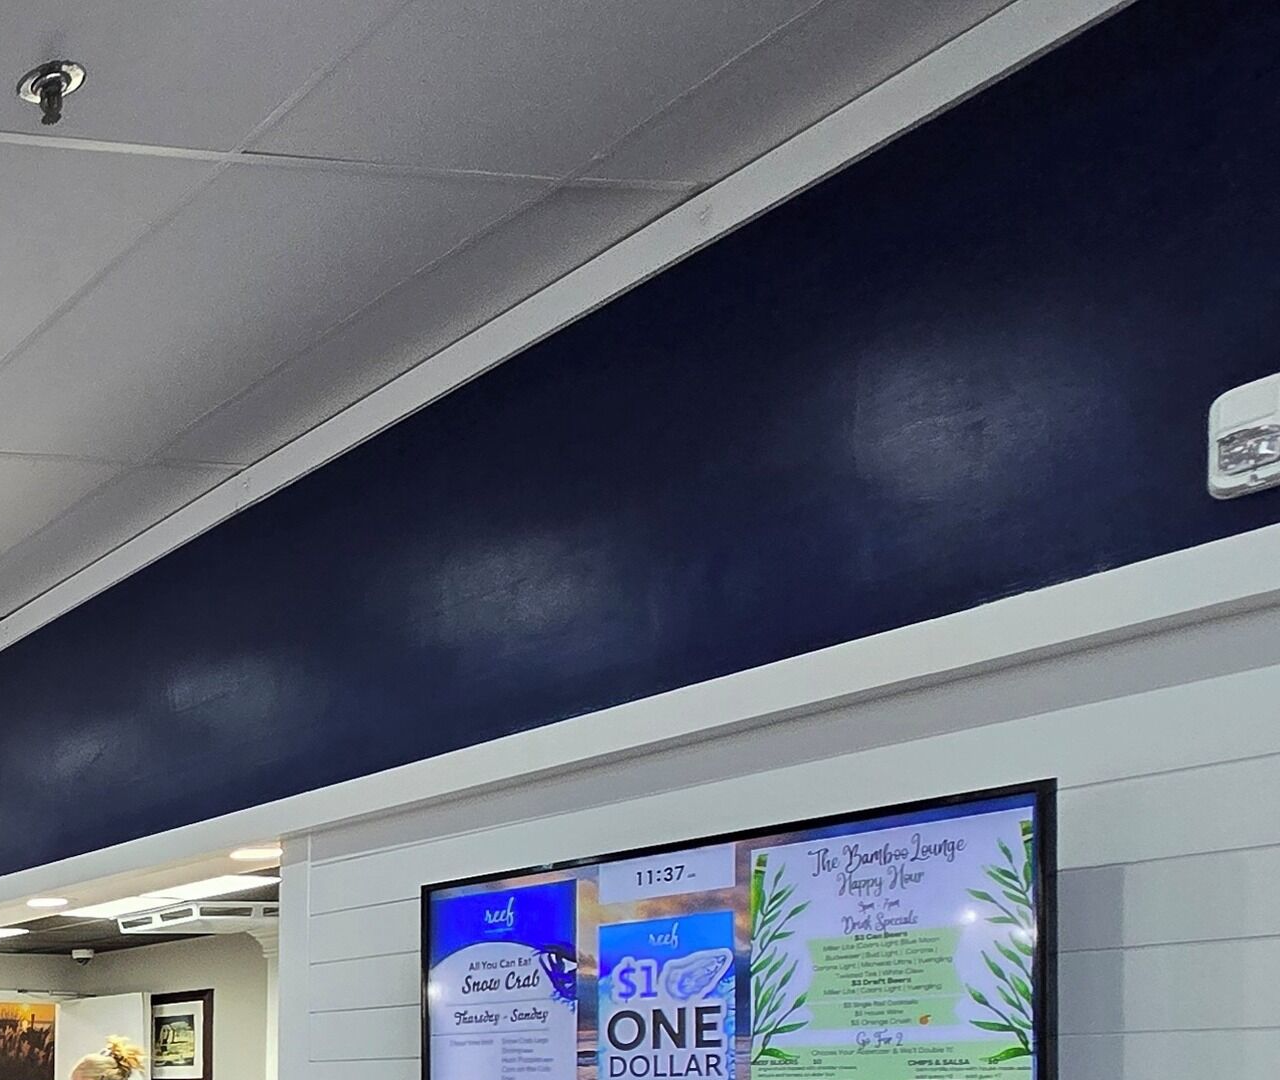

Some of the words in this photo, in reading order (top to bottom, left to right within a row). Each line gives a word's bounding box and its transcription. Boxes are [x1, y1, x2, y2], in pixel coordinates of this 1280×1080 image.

[808, 848, 838, 877] The
[842, 843, 909, 874] Bamboo
[910, 833, 967, 862] Lounge
[636, 865, 684, 886] 11:37
[836, 872, 882, 897] Happy
[888, 864, 925, 890] Hour
[484, 896, 514, 927] reef
[648, 922, 678, 948] reef
[468, 962, 480, 971] All
[482, 960, 498, 970] You
[500, 958, 516, 968] Can
[518, 957, 532, 967] Eat
[462, 974, 500, 994] Snow
[505, 969, 540, 990] Crab
[618, 962, 658, 1003] $1
[608, 1005, 722, 1051] ONE
[856, 1031, 870, 1046] Go
[896, 1032, 904, 1046] 2
[610, 1054, 723, 1078] DOLLAR
